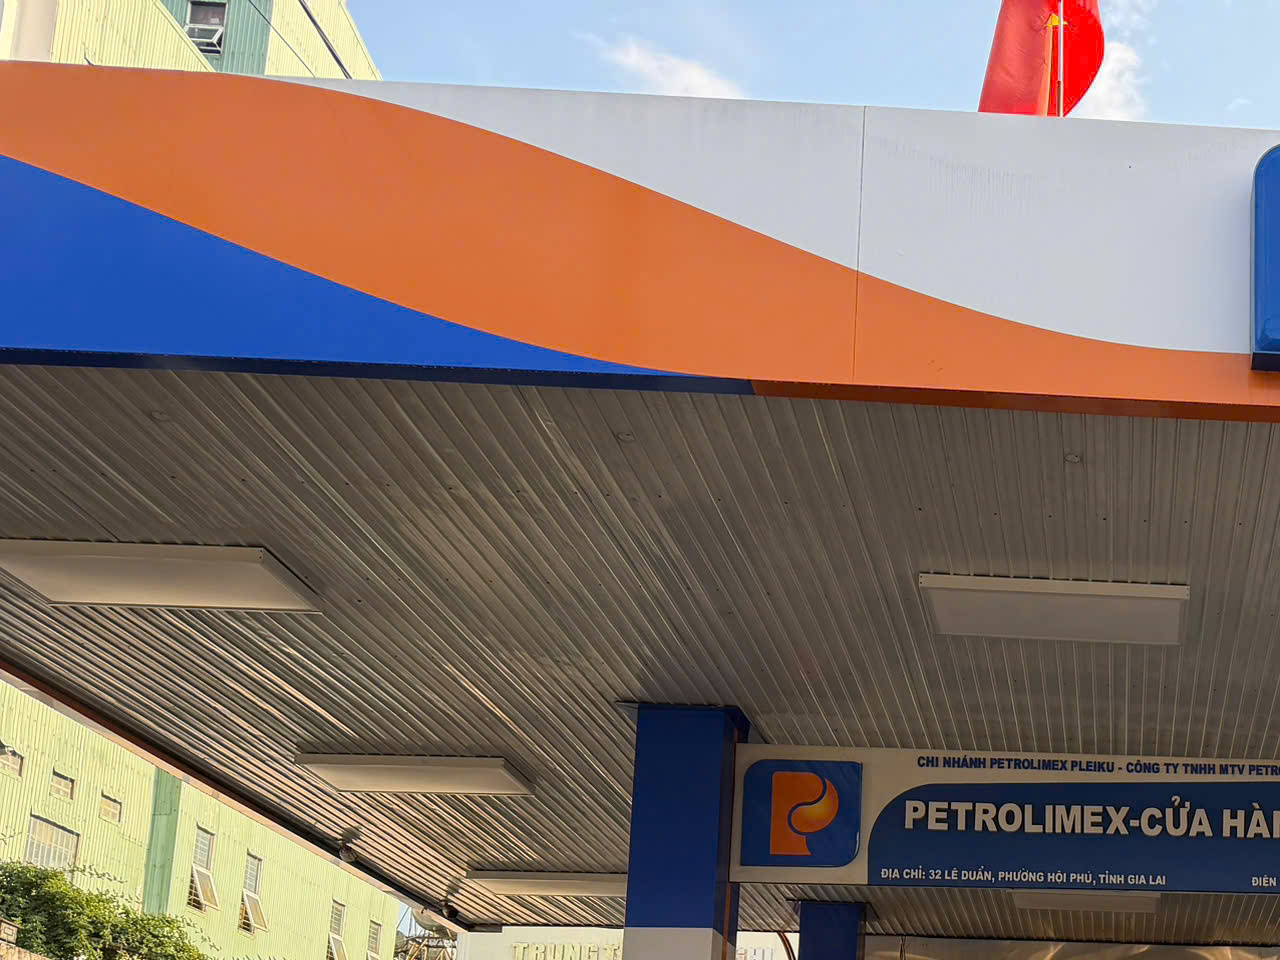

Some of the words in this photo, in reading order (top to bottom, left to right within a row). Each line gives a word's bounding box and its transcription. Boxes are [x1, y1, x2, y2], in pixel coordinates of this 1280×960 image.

[917, 756, 939, 768] CHI
[943, 755, 986, 769] NHÁNH
[990, 758, 1067, 771] PETROLIMEX
[1071, 761, 1115, 773] PLEIKU
[1126, 760, 1160, 774] CÔNG
[1164, 763, 1179, 774] TY
[1183, 763, 1216, 775] TNHH
[1219, 764, 1245, 776] MTV
[904, 795, 1213, 839] PETROLIMEX-CỬA
[881, 868, 900, 881] ĐỊA
[903, 865, 926, 879] CHỈ:
[929, 869, 942, 880] 32
[945, 866, 959, 880] LÊ
[998, 867, 1044, 882] PHƯỜNG
[1047, 869, 1067, 884] HỘI
[1070, 869, 1096, 885] PHÚ,
[1099, 870, 1124, 885] TỈNH
[1128, 874, 1146, 885] GIA
[1149, 874, 1166, 885] LAI
[1251, 874, 1277, 888] ĐIỆN
